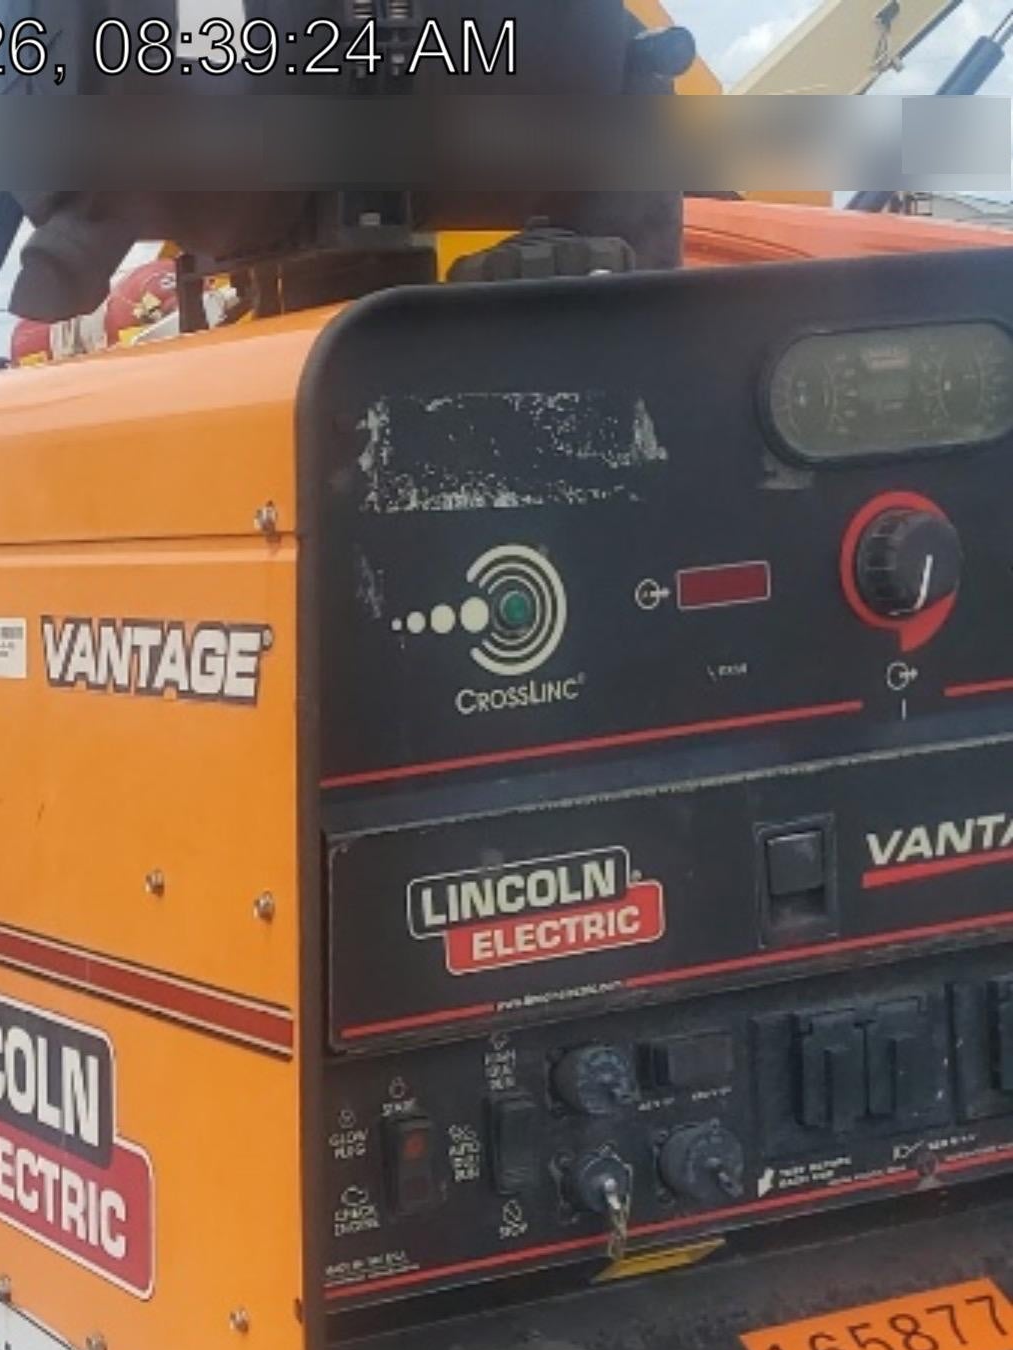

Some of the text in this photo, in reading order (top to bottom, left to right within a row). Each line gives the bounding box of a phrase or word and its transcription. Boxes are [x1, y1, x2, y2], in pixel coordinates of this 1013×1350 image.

[42, 618, 264, 702] VANTAGE
[421, 857, 616, 928] LINCOLN
[471, 904, 640, 962] ELECTRIC
